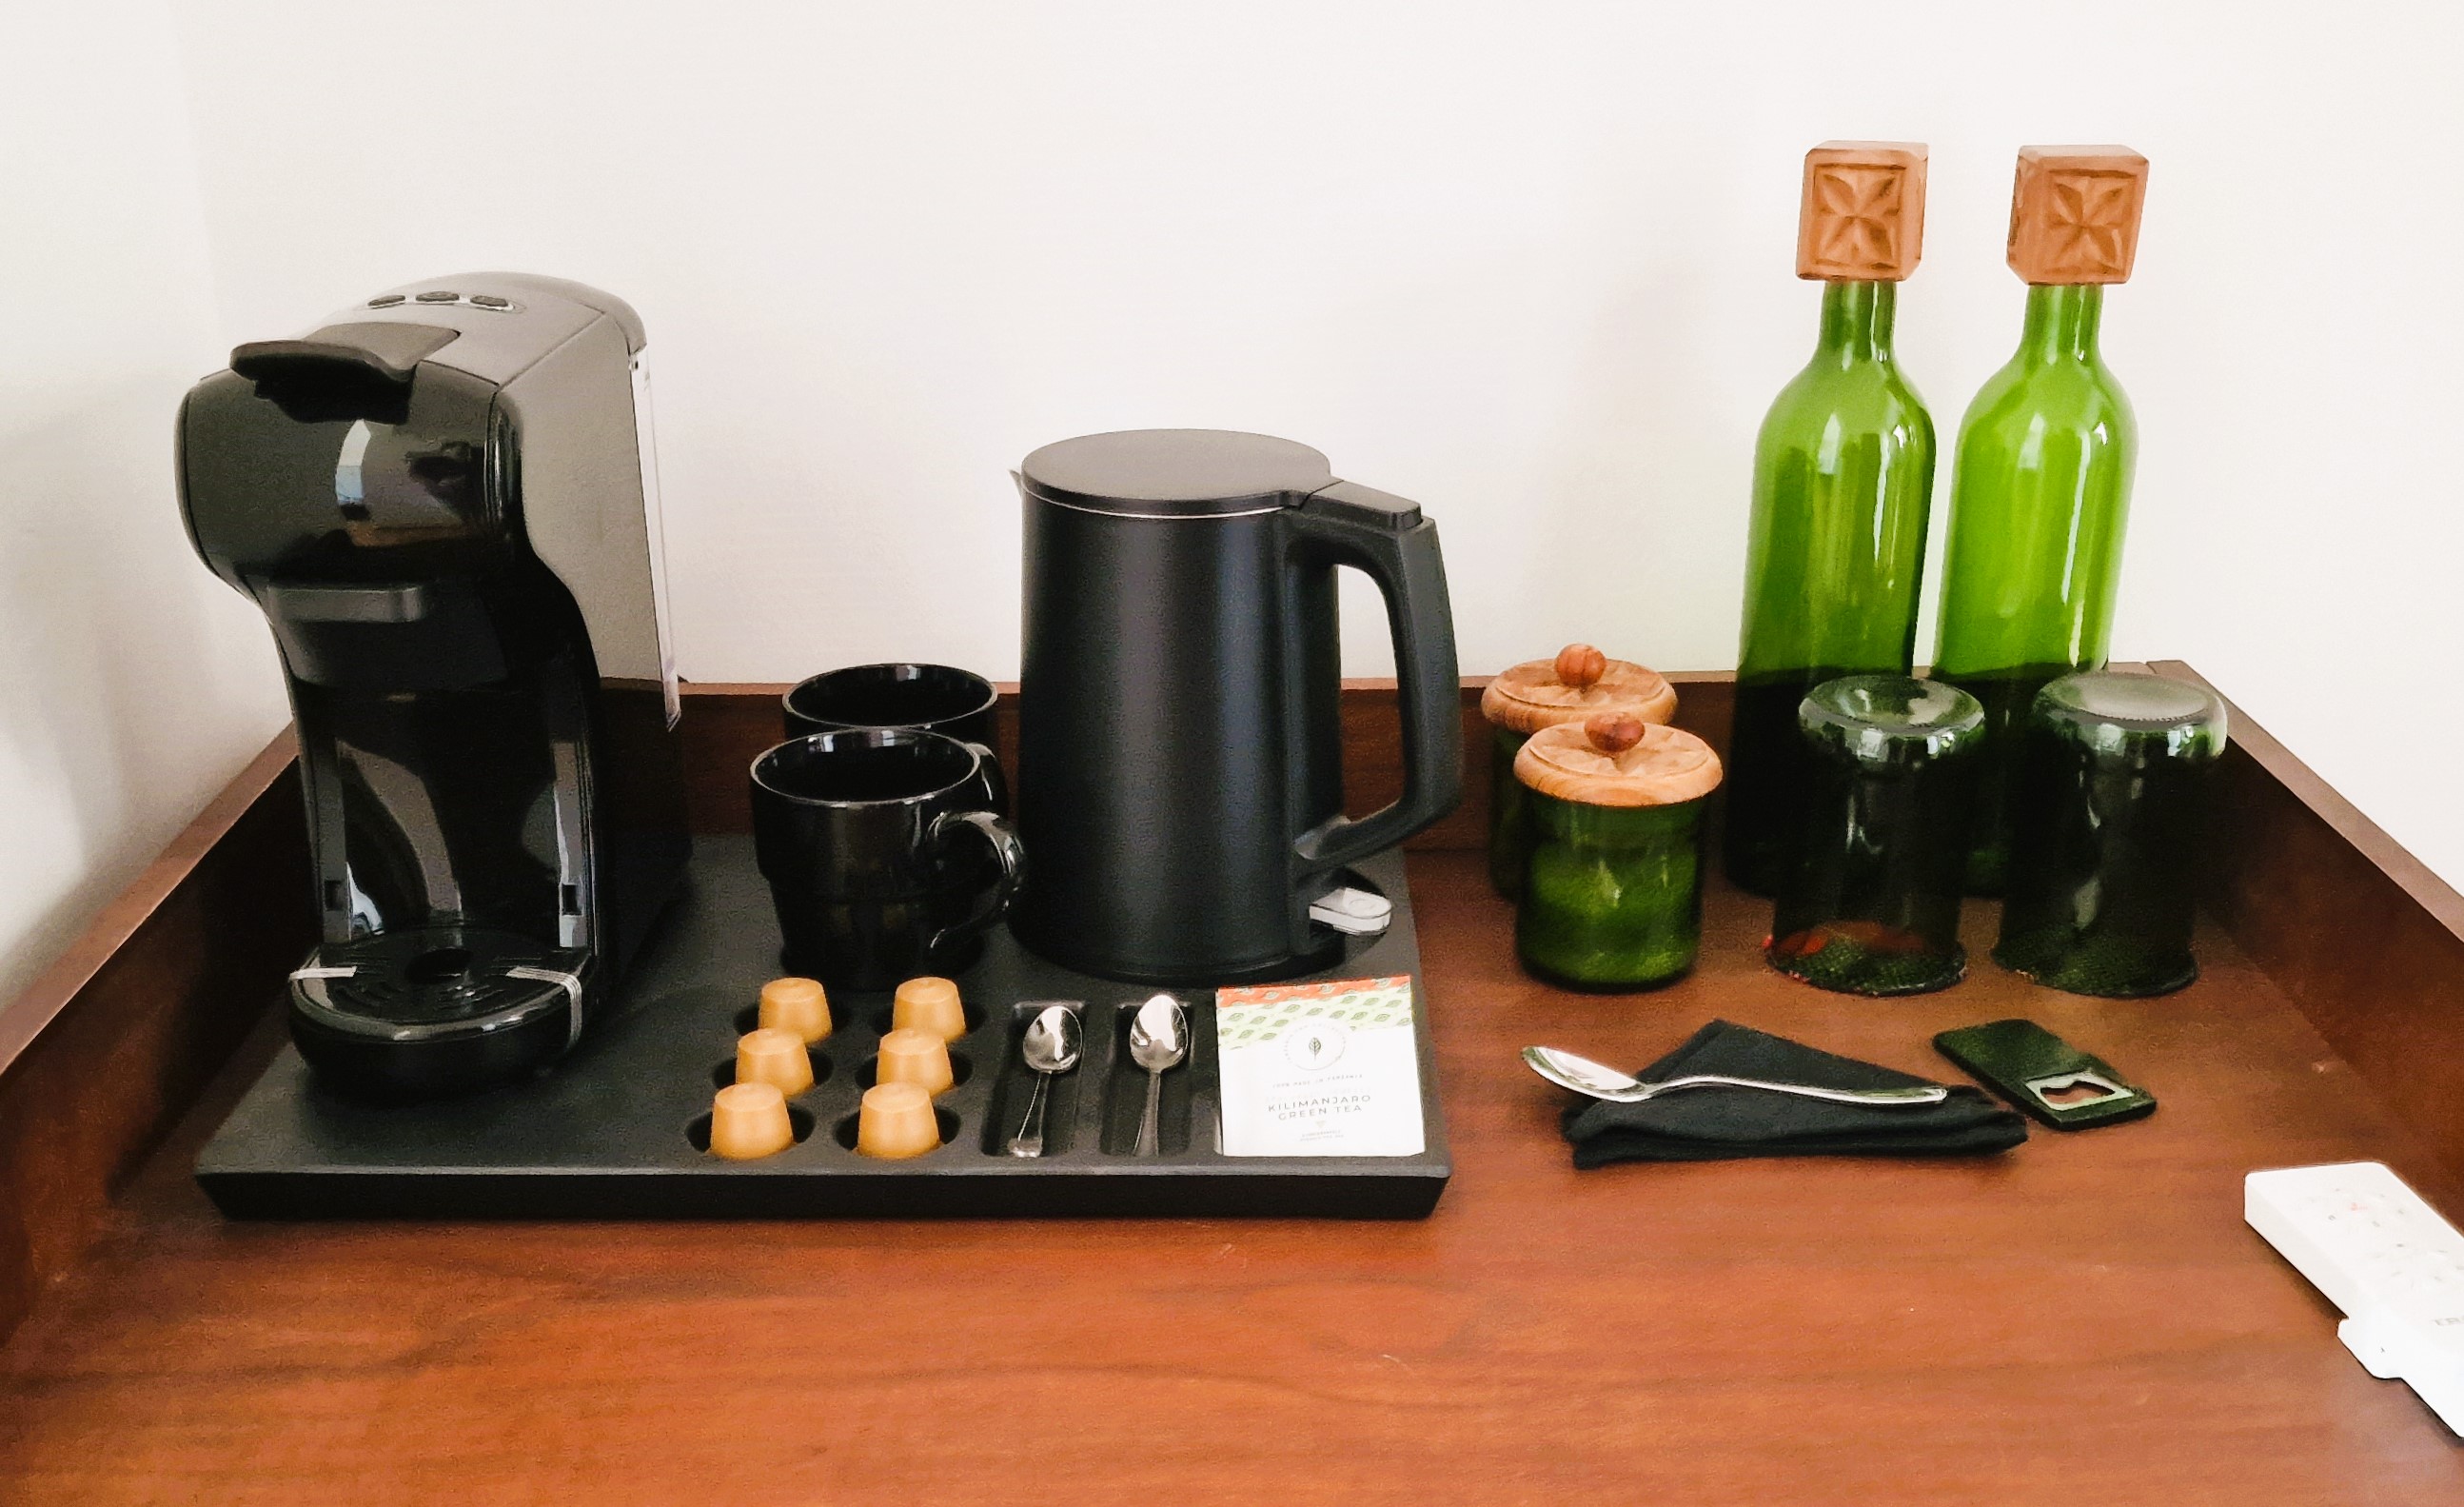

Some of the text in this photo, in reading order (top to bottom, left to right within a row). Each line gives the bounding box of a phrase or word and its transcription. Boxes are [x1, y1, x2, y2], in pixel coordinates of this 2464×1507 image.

[1268, 1095, 1371, 1112] KILIMANJARO
[1277, 1104, 1363, 1121] GREEN TEA
